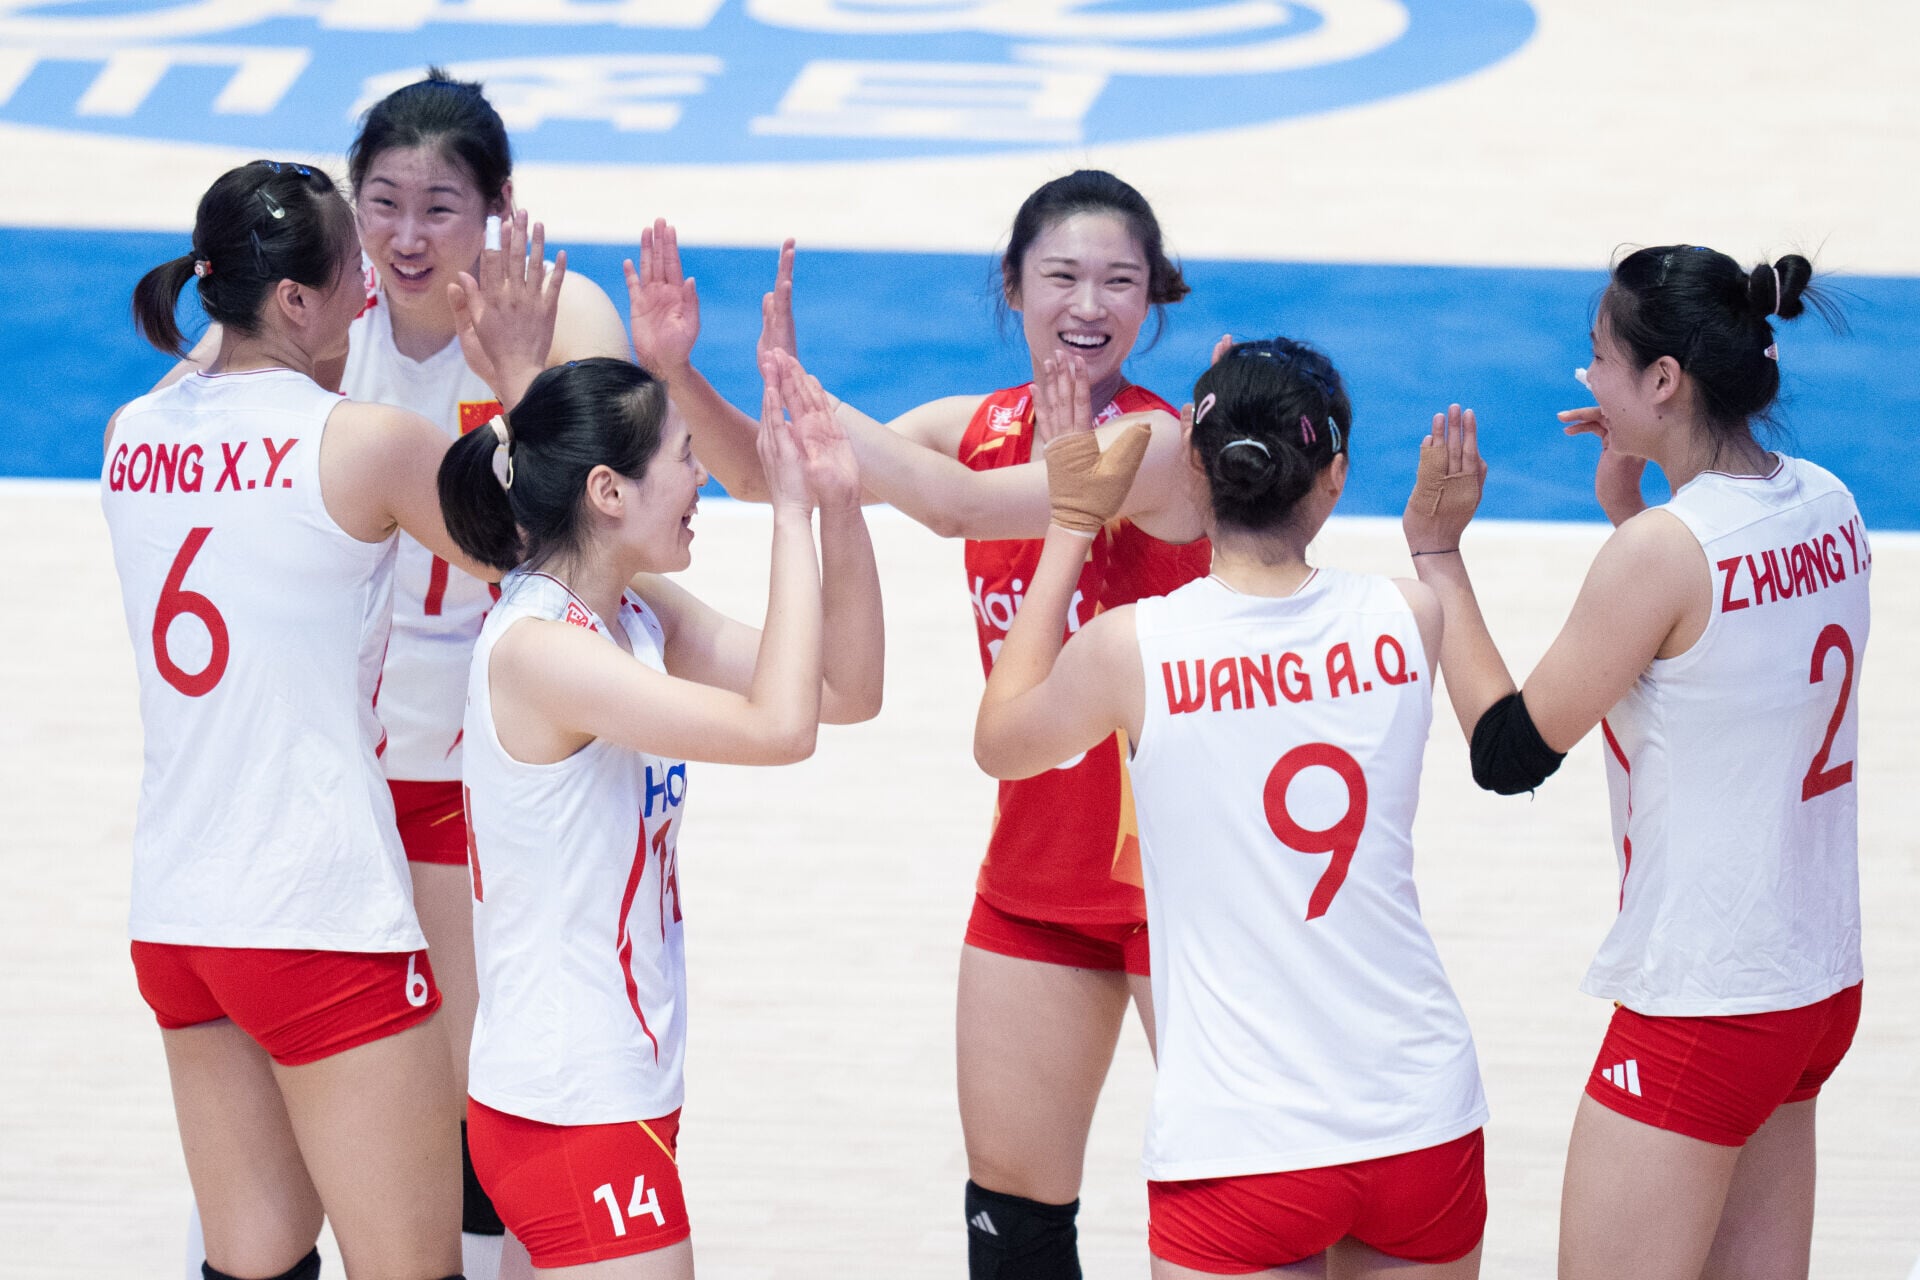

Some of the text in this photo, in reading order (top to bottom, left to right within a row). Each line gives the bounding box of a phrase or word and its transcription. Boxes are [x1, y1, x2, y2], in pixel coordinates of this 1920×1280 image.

[109, 437, 300, 494] GONG X.Y.
[152, 527, 230, 698] 6
[971, 576, 1084, 633] Hair
[1716, 533, 1847, 614] ZHUANG
[1161, 634, 1418, 716] WANG A.Q.
[1801, 623, 1855, 803] 2
[1263, 742, 1369, 922] 9
[405, 953, 428, 1008] 6
[592, 1174, 666, 1237] 14
